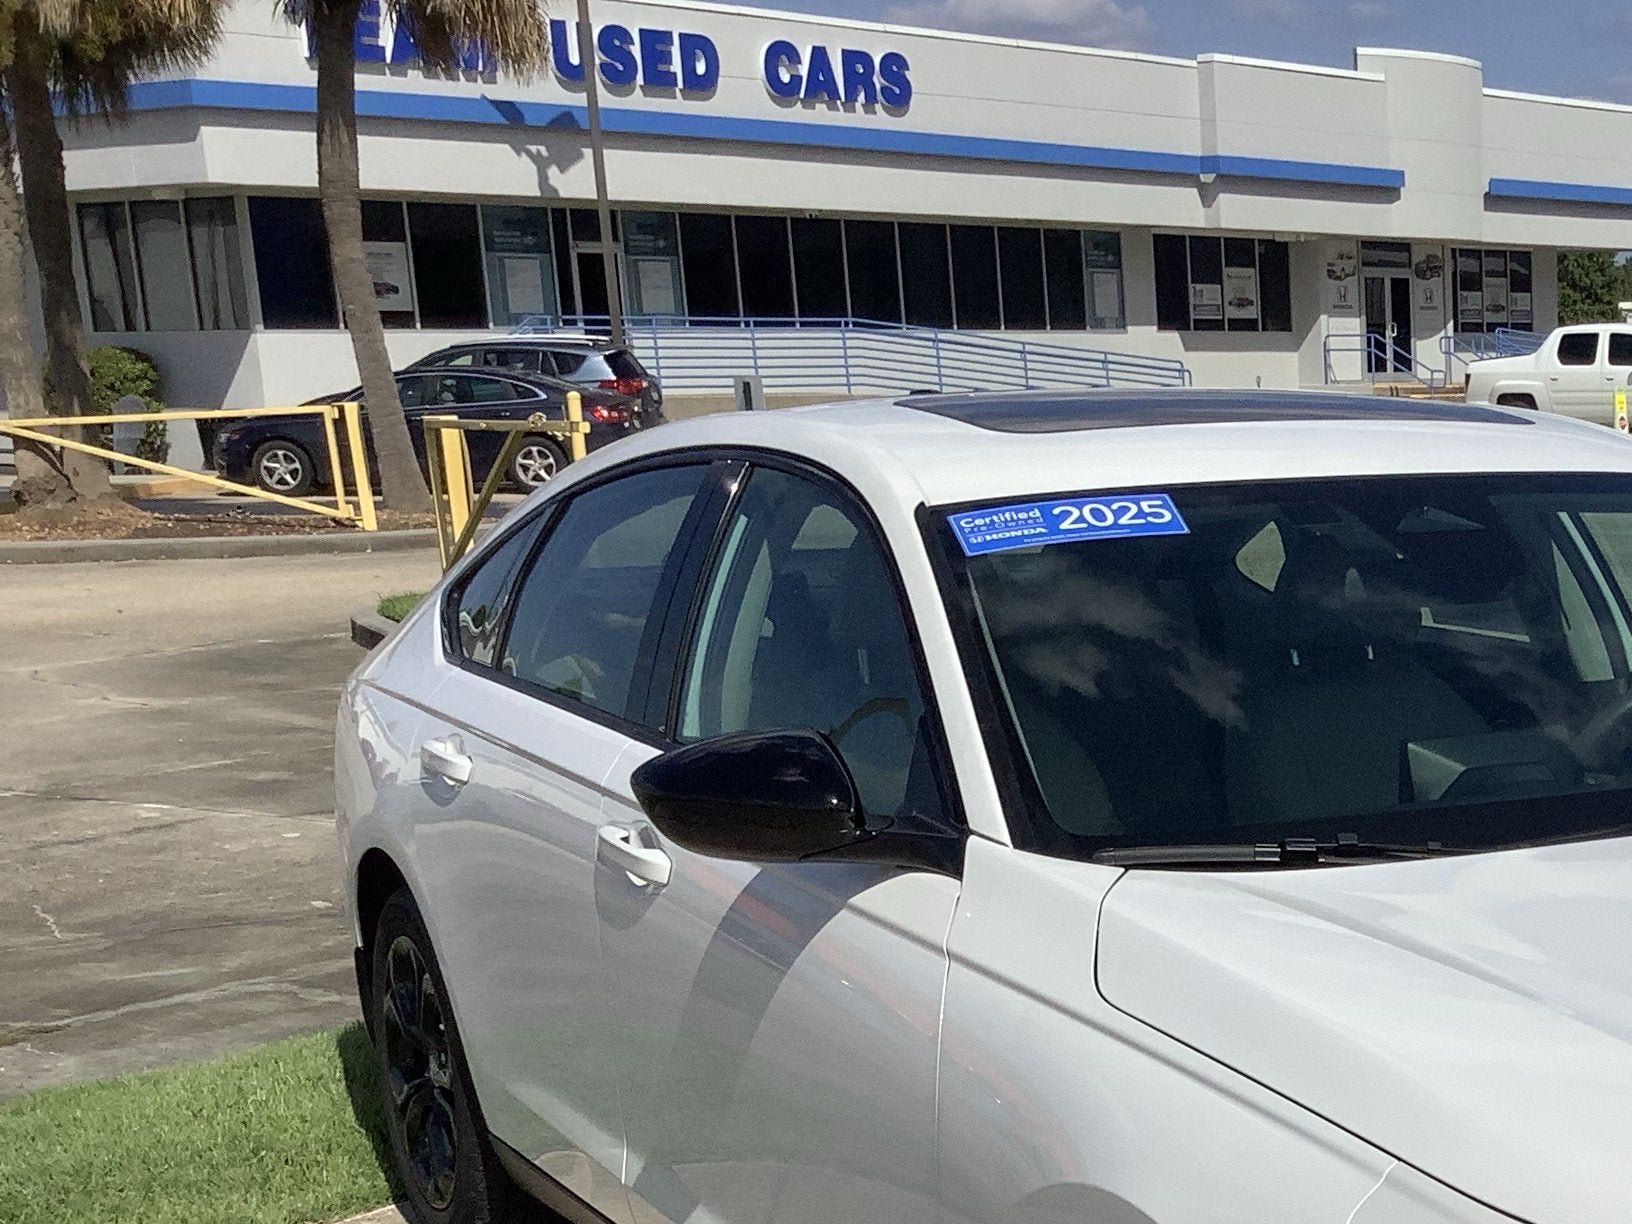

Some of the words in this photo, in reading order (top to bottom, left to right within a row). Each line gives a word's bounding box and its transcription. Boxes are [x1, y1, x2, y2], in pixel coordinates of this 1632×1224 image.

[550, 18, 721, 91] USED
[763, 39, 913, 108] CARS
[959, 507, 1041, 529] Certified
[964, 516, 1044, 534] Pre-Owned
[1051, 499, 1173, 531] 2025
[984, 526, 1049, 543] HONDA
